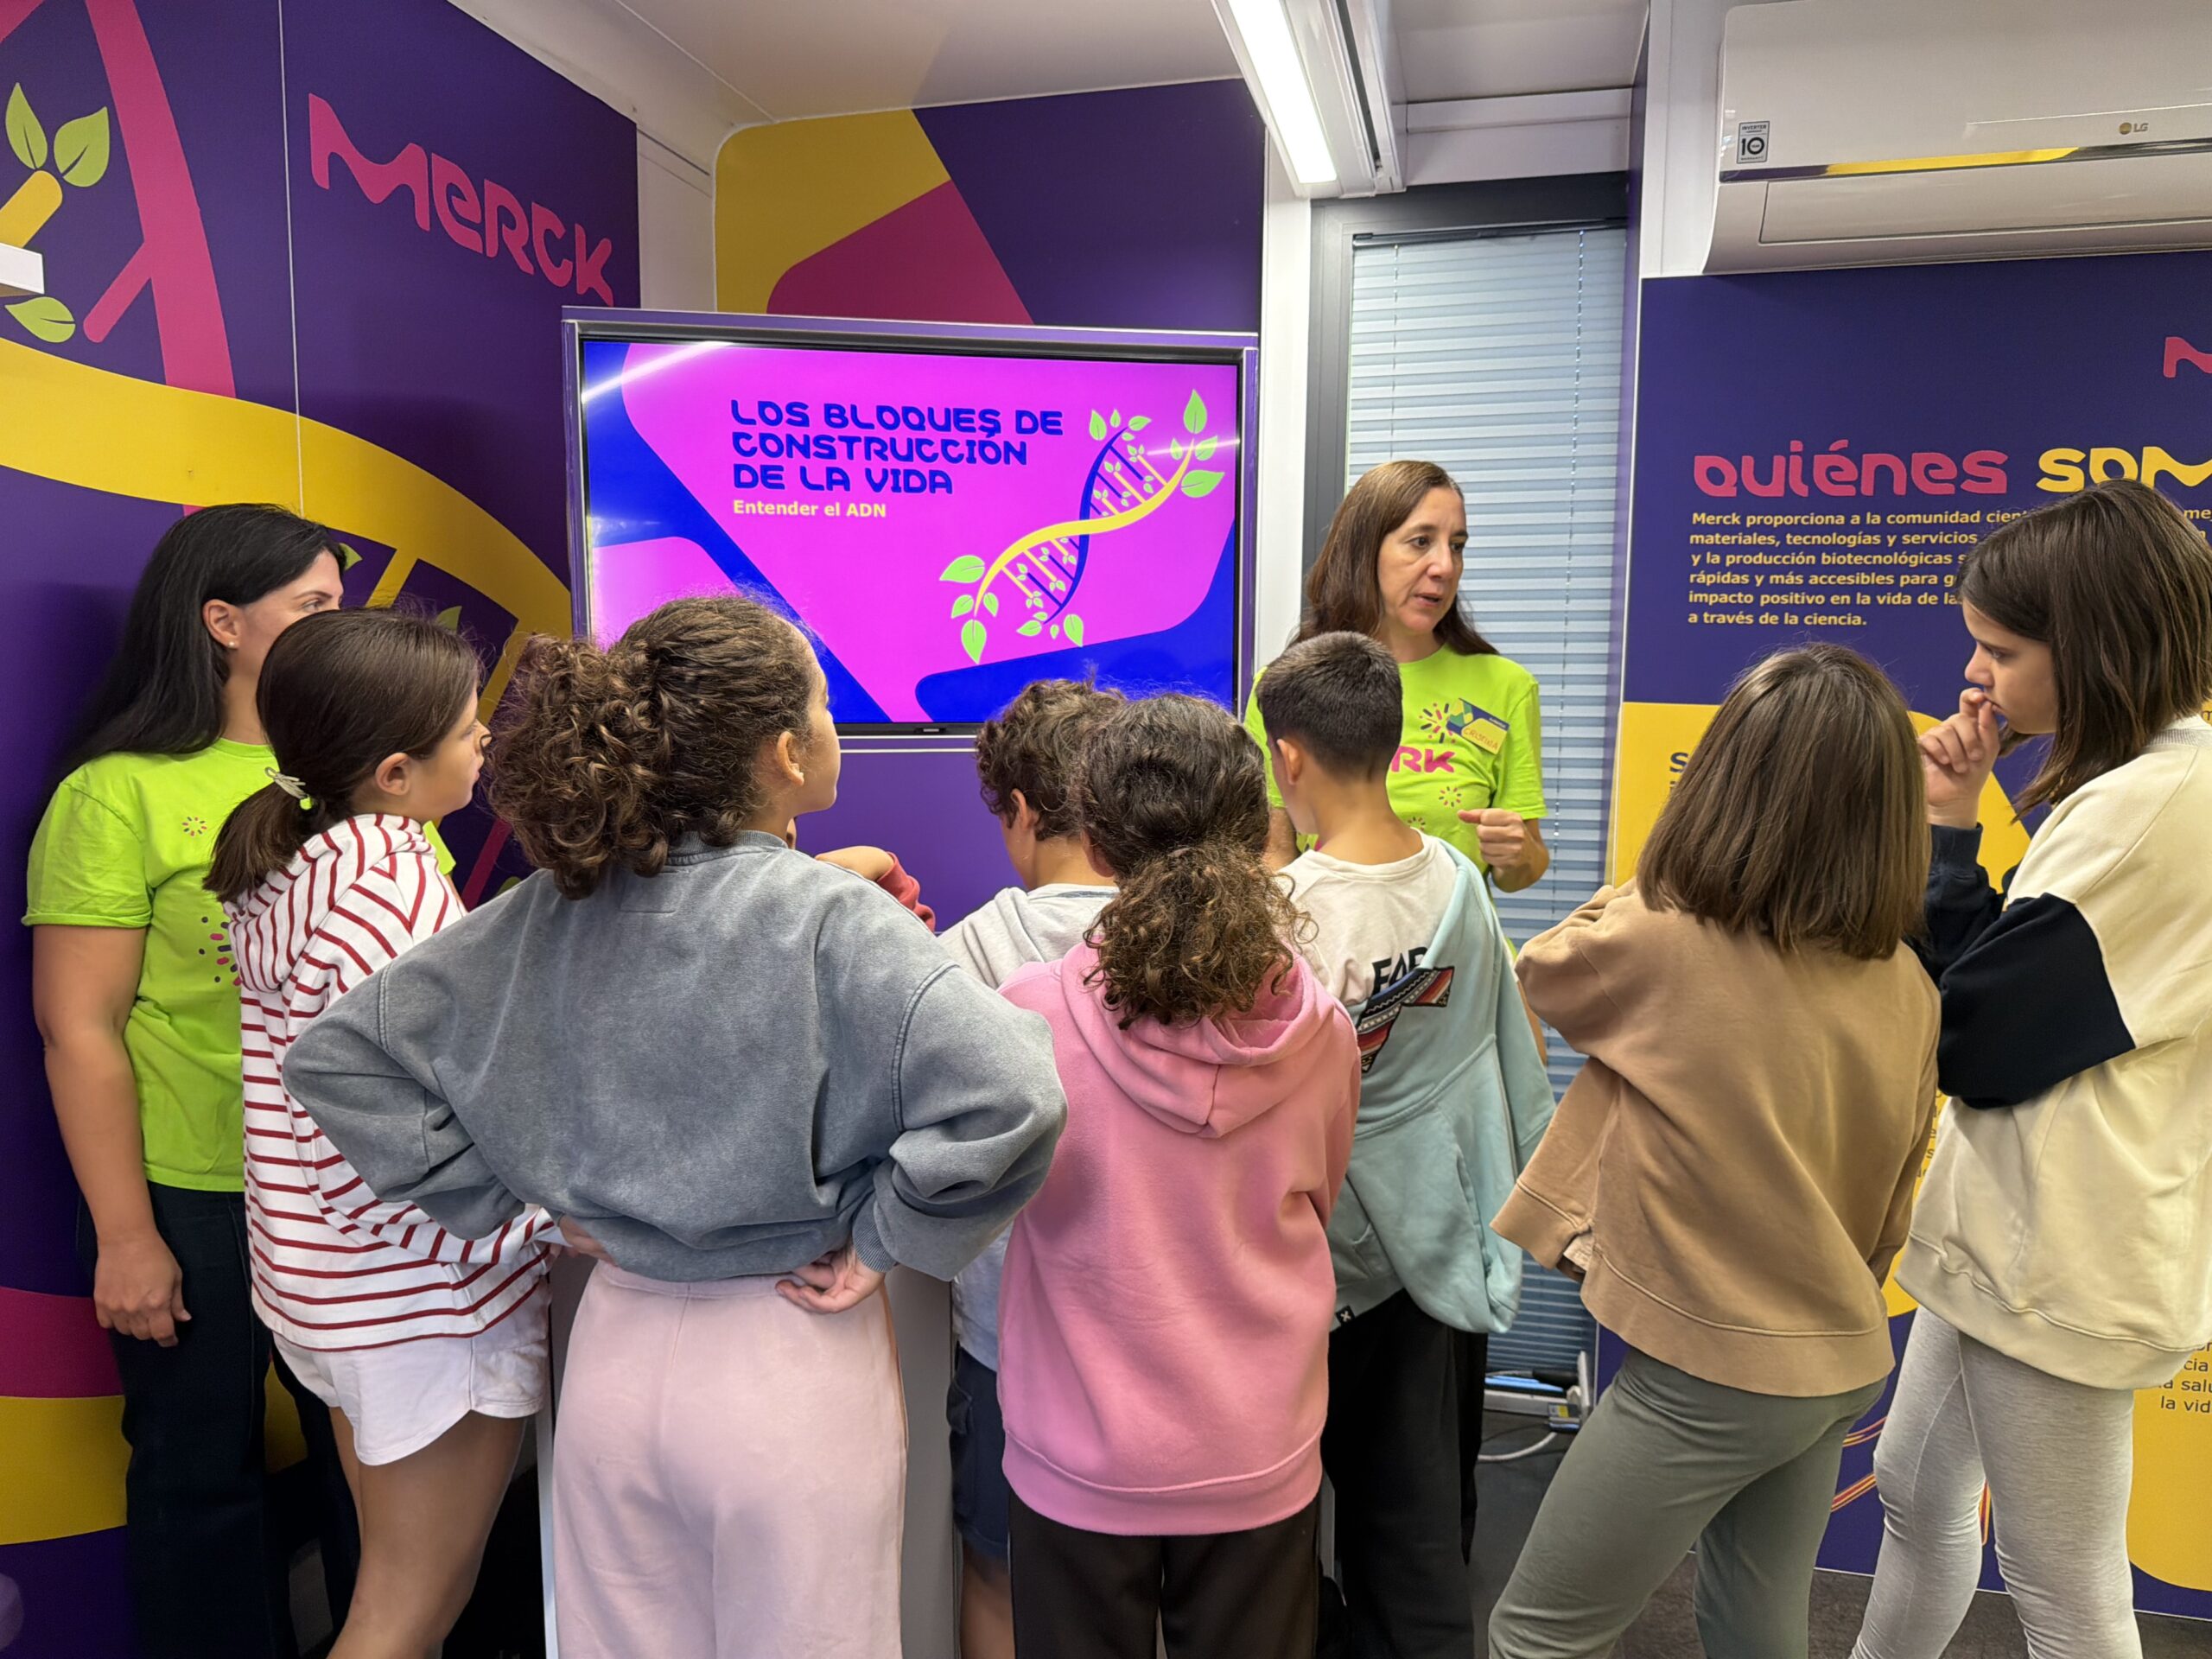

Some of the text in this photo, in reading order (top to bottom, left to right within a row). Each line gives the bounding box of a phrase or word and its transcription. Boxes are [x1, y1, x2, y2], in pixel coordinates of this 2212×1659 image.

[2133, 123, 2149, 133] LG
[1741, 137, 1764, 156] 10
[731, 399, 1064, 435] LOS BLOQUES DE
[732, 430, 1027, 466] CONSTRUCCIÓN
[734, 463, 952, 494] DE LA VIDA
[734, 499, 887, 518] Entender el ADN
[1692, 512, 1741, 525] Merck
[1745, 512, 1846, 528] proporciona
[1850, 514, 1860, 524] a
[1866, 512, 1882, 524] la
[1886, 511, 1980, 524] comunidad
[1689, 531, 1978, 548] materiales, tecnologías y servicios
[1691, 554, 1701, 566] y
[1706, 551, 1720, 564] la
[1726, 551, 1815, 567] producción
[1821, 551, 1953, 568] biotecnológicas
[1689, 570, 1750, 587] rápidas
[1754, 574, 1764, 587] y
[1769, 571, 1804, 585] más
[1808, 572, 1894, 585] accesibles
[1899, 575, 1938, 588] para
[1688, 590, 1961, 607] impacto positivo en la vida de la
[1688, 611, 1867, 626] a través de la ciencia.
[2161, 1395, 2176, 1409] la
